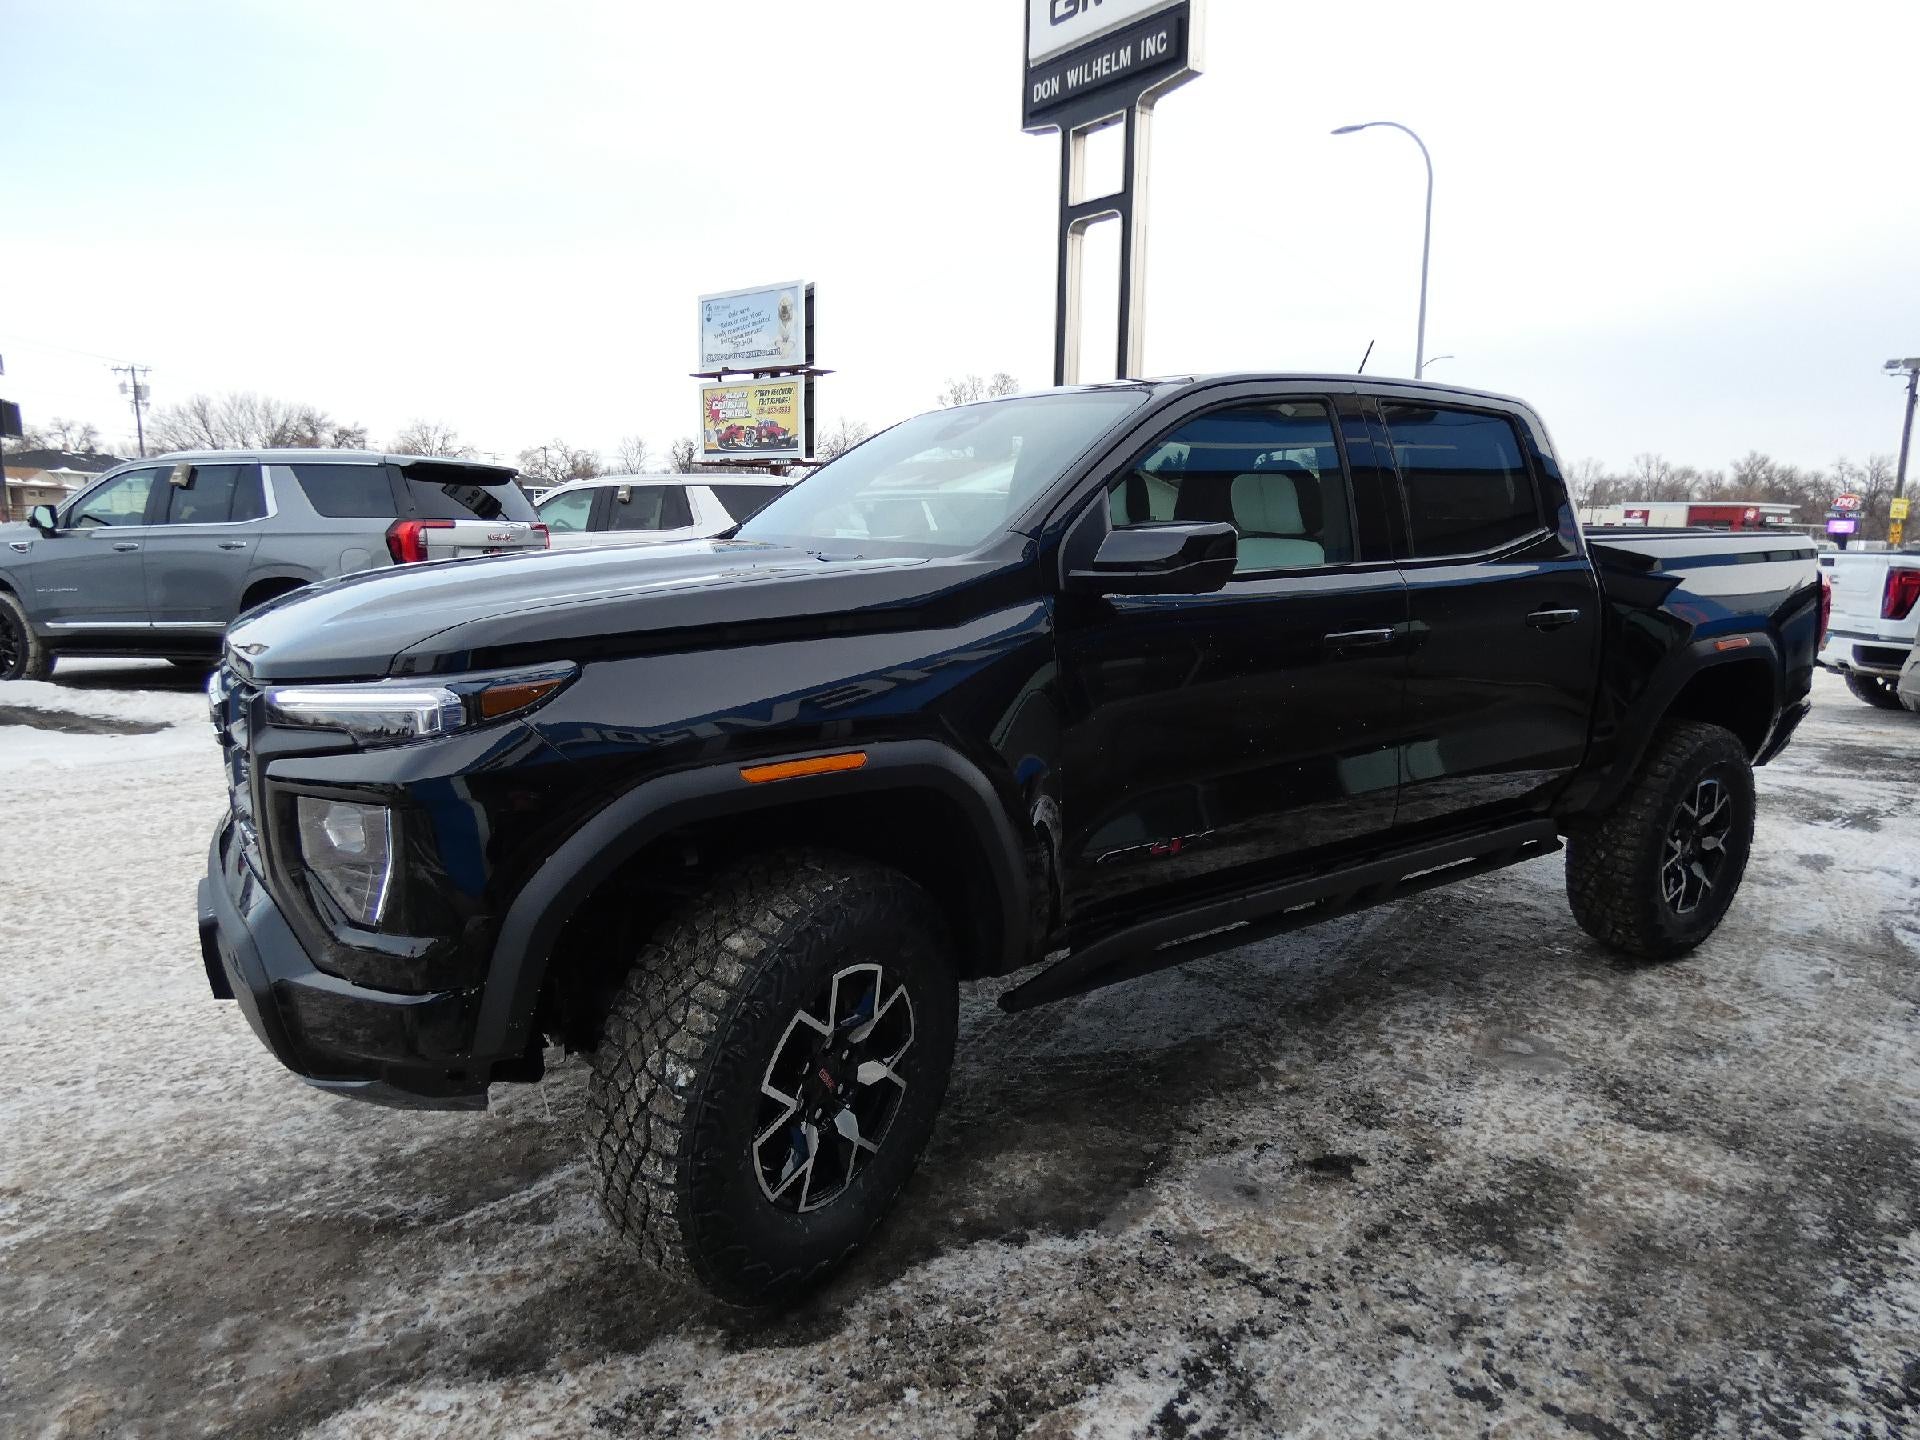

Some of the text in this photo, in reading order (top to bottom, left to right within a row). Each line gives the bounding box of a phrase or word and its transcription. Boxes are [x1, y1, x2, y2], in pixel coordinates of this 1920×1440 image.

[1033, 31, 1167, 103] DON WILHELM INC
[1836, 497, 1855, 508] DQ
